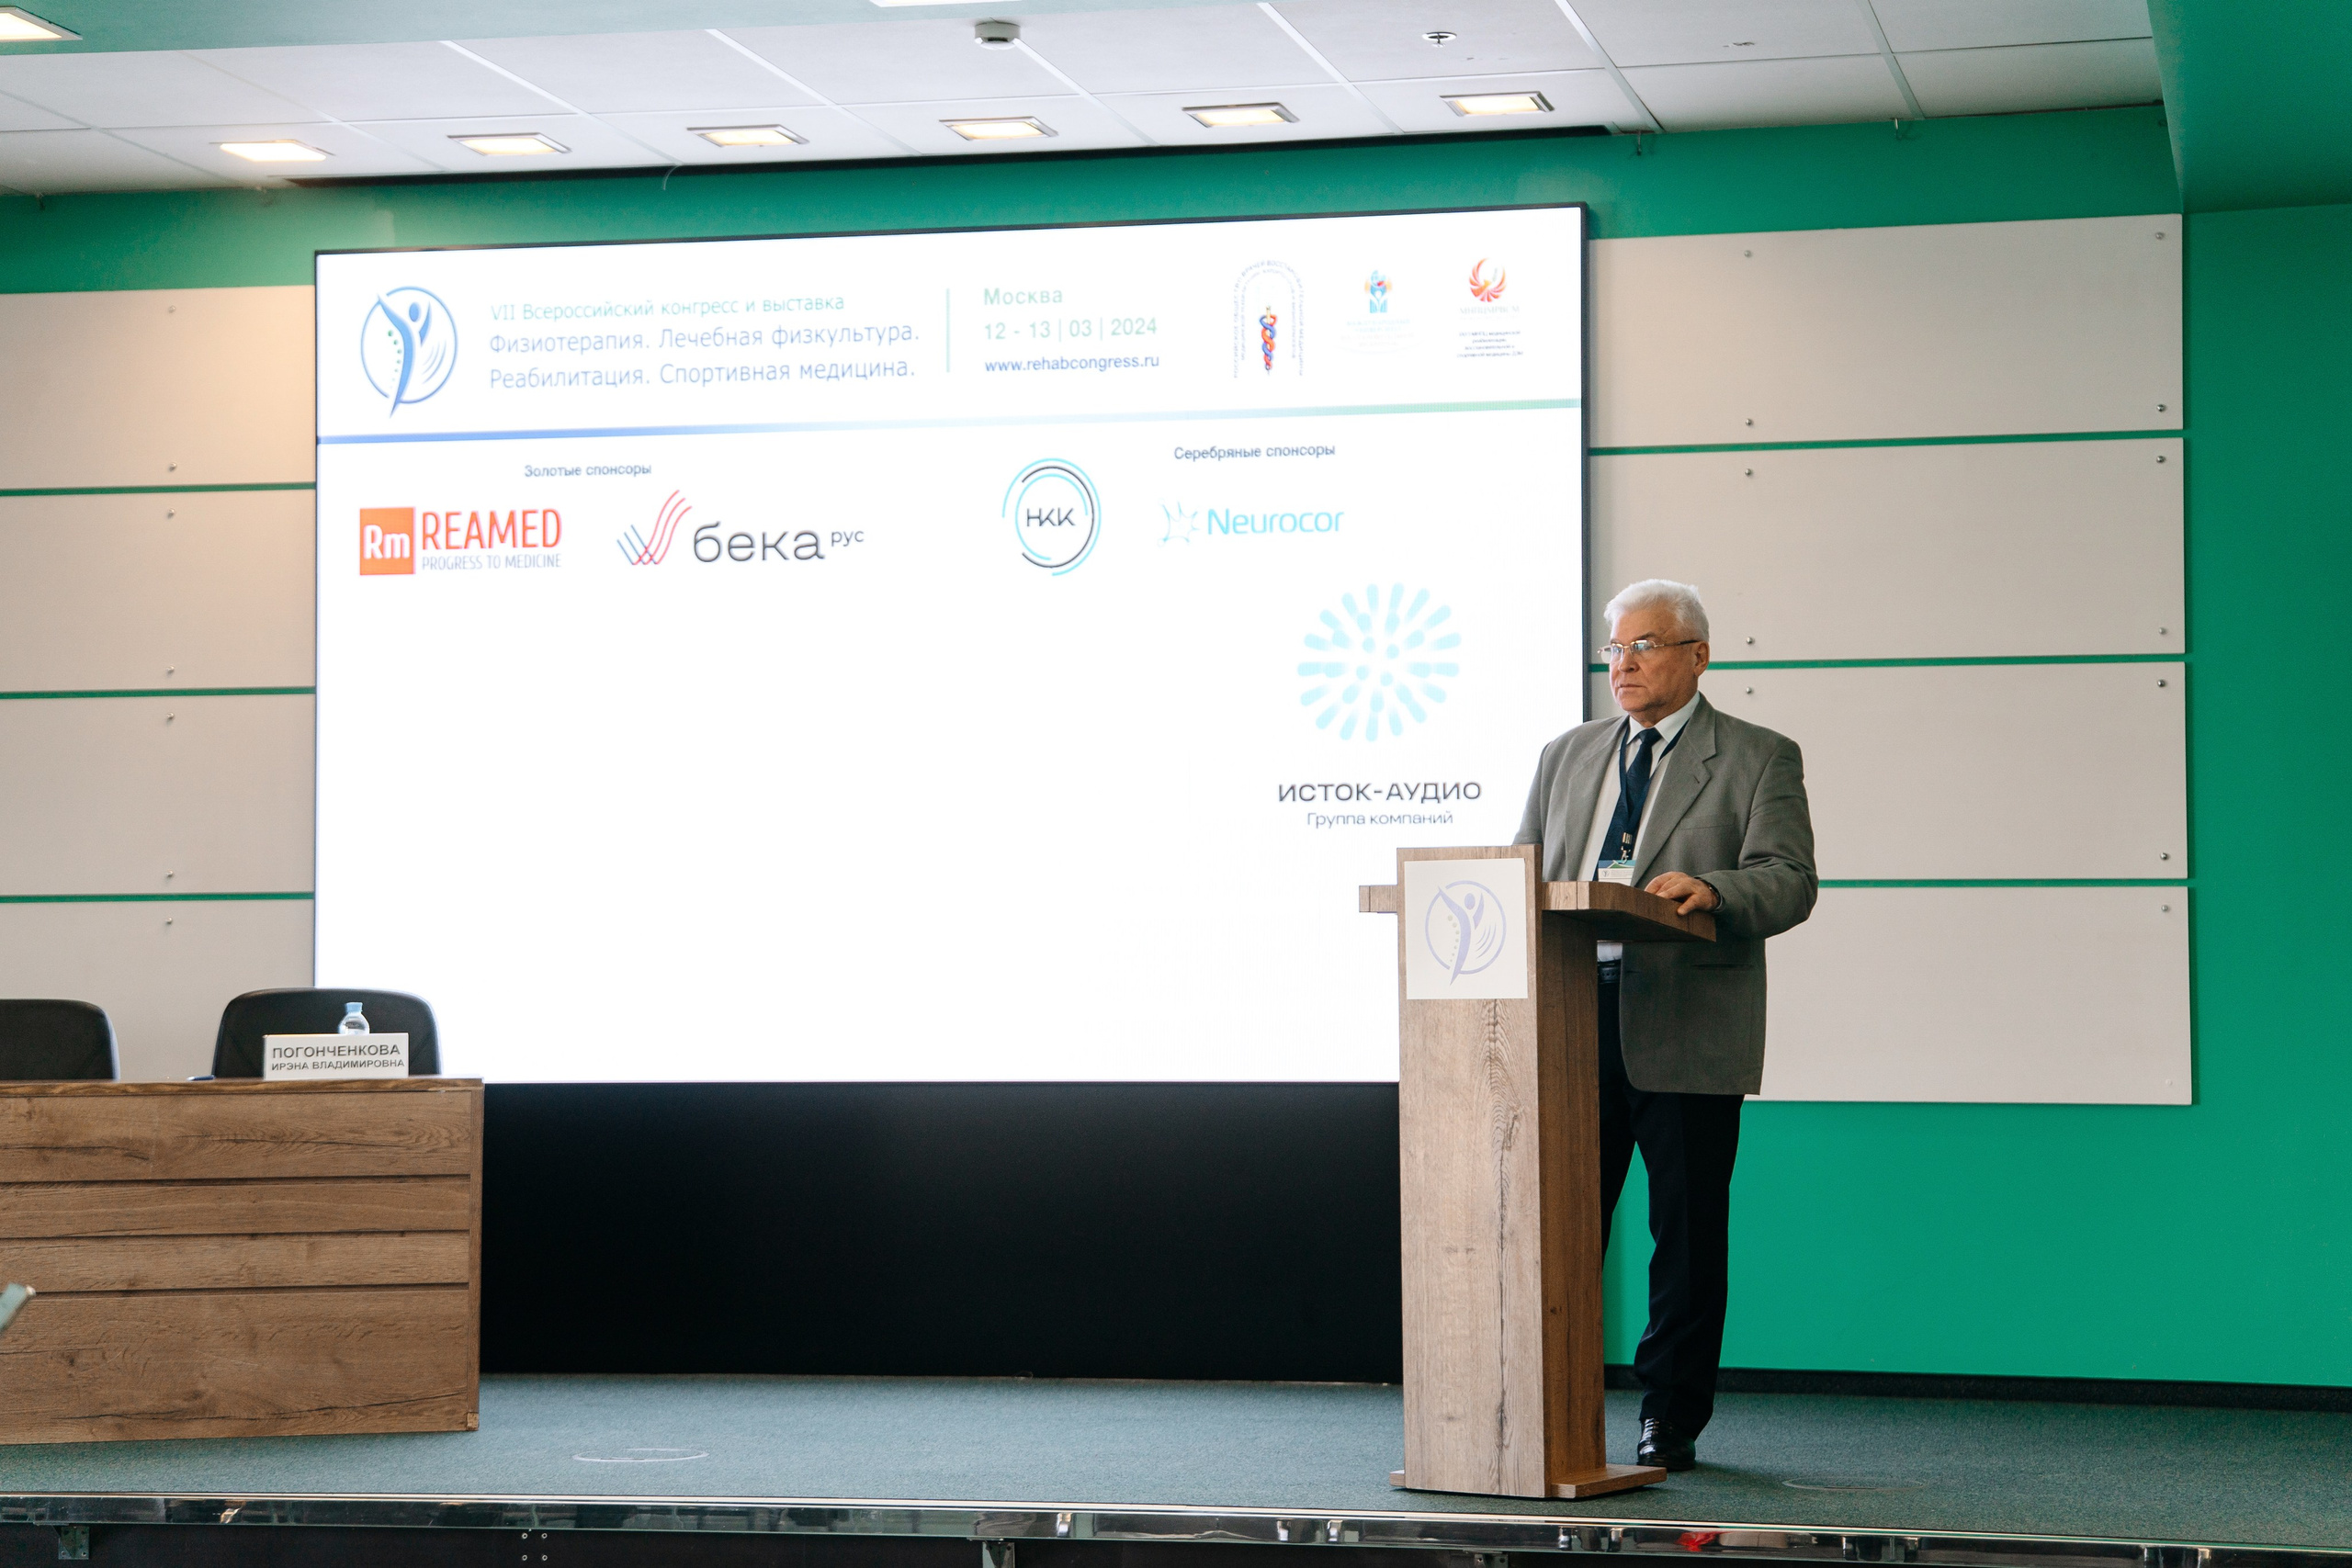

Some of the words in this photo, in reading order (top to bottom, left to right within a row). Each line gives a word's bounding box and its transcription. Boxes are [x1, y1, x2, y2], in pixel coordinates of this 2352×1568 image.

[984, 288, 1063, 305] Москва
[491, 304, 514, 321] VII
[523, 299, 653, 321] Всероссийский
[662, 299, 739, 317] конгресс
[746, 300, 755, 312] и
[763, 297, 844, 312] выставка
[985, 322, 1006, 340] 12
[1029, 321, 1051, 338] 13
[1069, 320, 1092, 337] 03
[1111, 317, 1158, 336] 2024
[490, 334, 650, 355] Физиотерапия.
[659, 326, 763, 348] Лечебная
[772, 324, 919, 349] физкультура.
[985, 355, 1159, 372] www.rehabcongress.ru
[491, 367, 650, 389] Реабилитация.
[660, 363, 790, 387] Спортивная
[799, 360, 915, 381] медицина.
[1174, 446, 1261, 462] Серебряные
[1266, 446, 1336, 458] спонсоры
[525, 465, 582, 478] Золотые
[586, 464, 652, 477] спонсоры
[423, 508, 562, 550] REAMED
[1207, 508, 1344, 536] Neurocor
[363, 525, 411, 559] Rm
[694, 521, 825, 563] бека
[831, 530, 865, 547] рус
[422, 556, 482, 570] PROGRESS
[487, 555, 502, 569] TO
[504, 553, 562, 569] MEDICINE
[1279, 783, 1481, 804] ИСТОК-АУДИО
[1307, 812, 1366, 829] Группа
[1371, 810, 1453, 825] компаний
[273, 1044, 401, 1059] ПОГОНЧЕНКОВА
[272, 1062, 309, 1071] ИРЭНА
[312, 1059, 404, 1069] ВЛАДИМИРОВНА
